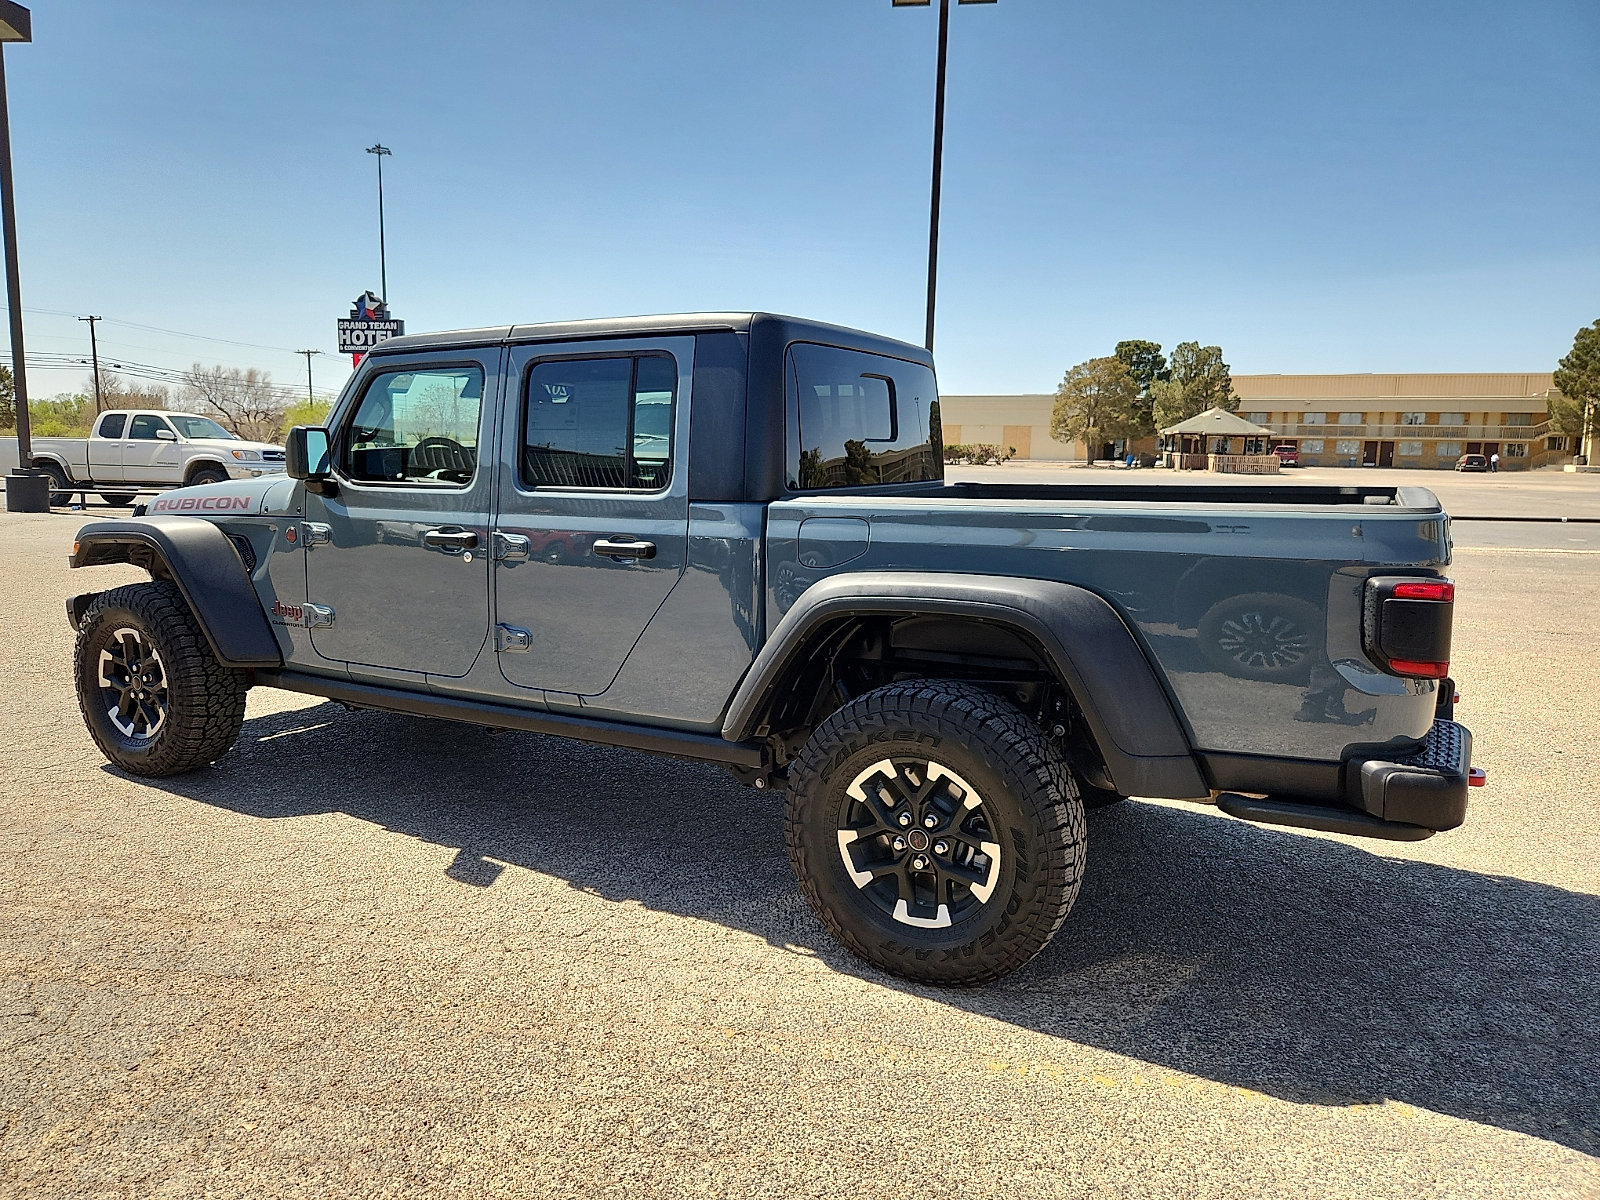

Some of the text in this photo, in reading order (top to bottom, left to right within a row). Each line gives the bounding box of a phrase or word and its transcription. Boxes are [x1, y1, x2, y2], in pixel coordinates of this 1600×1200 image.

[338, 321, 397, 330] GRAND TEXAN
[152, 496, 251, 511] RUBICON
[271, 600, 303, 621] Jeep
